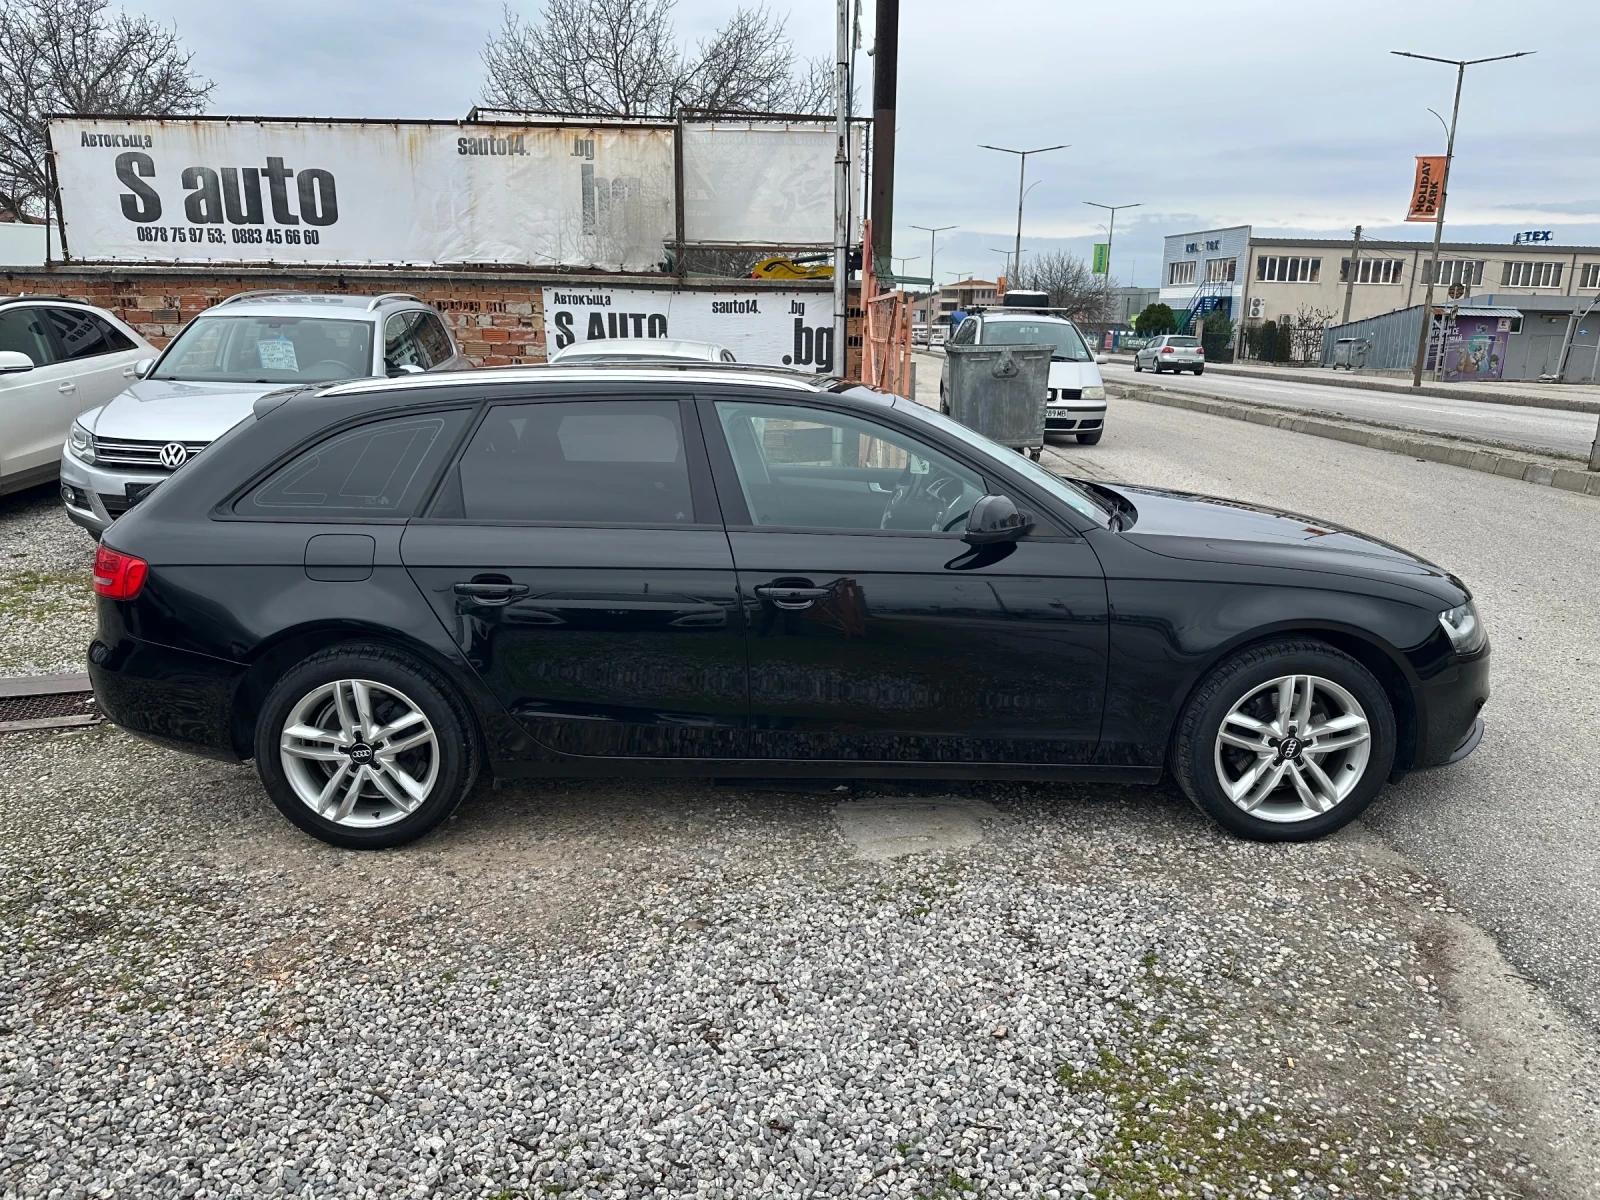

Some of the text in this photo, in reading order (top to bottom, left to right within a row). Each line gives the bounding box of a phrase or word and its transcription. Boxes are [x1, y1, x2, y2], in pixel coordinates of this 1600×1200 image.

[81, 131, 152, 149] Автокъща
[457, 134, 530, 156] sauto14.
[570, 135, 594, 160] .bg
[115, 151, 338, 227] S auto
[1414, 160, 1431, 212] HOLIDAY
[1425, 181, 1438, 212] PARK
[137, 226, 319, 245] 0878 75 97 53; 0883 45 66 60
[1206, 239, 1220, 251] TEX
[1525, 230, 1552, 242] TEX
[554, 292, 611, 307] Автокъща
[712, 300, 761, 314] sauto14.
[787, 300, 805, 316] .bg
[554, 311, 575, 349] S
